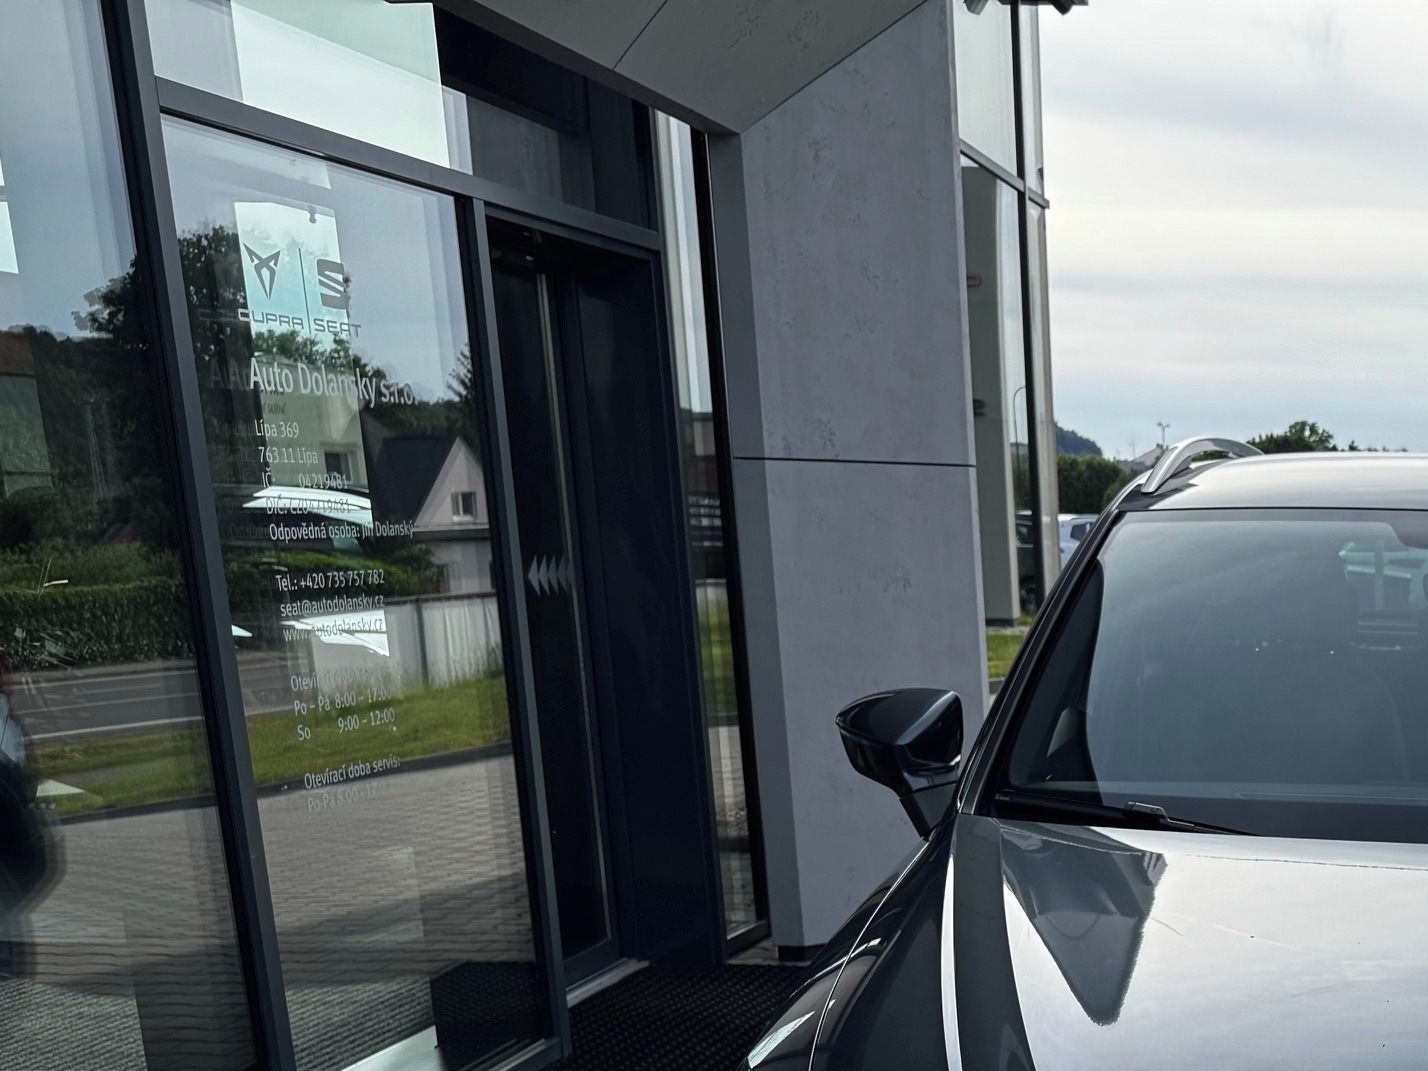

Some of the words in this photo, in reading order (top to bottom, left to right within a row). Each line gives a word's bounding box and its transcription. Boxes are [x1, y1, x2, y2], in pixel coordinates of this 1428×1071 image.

[238, 308, 304, 329] CUPRA
[313, 318, 362, 338] SEAT
[249, 357, 294, 393] Auto
[298, 362, 377, 408] Dolanský
[380, 376, 419, 406] s.r.o.
[254, 418, 278, 440] Lípa
[280, 422, 299, 439] 369
[258, 446, 279, 464] 763
[283, 448, 295, 464] 11
[298, 447, 318, 466] Lípa
[299, 473, 349, 489] 04219481
[269, 521, 327, 543] Odpovědná
[328, 521, 360, 540] osoba:
[375, 519, 415, 540] Dolanský
[275, 573, 298, 592] Tel.:
[300, 572, 326, 589] +420
[328, 571, 346, 588] 735
[347, 570, 365, 587] 757
[367, 569, 385, 585] 782
[280, 593, 385, 617] seat@autodolansky.cz
[294, 700, 307, 717] Po
[318, 695, 331, 711] Pá
[335, 690, 356, 709] 8:00
[367, 684, 392, 703] 17:00
[297, 724, 311, 741] So
[338, 714, 360, 735] 9:00
[370, 707, 395, 726] 12:00
[304, 764, 347, 789] Otevírací
[349, 760, 371, 779] doba
[373, 755, 400, 774] servis:
